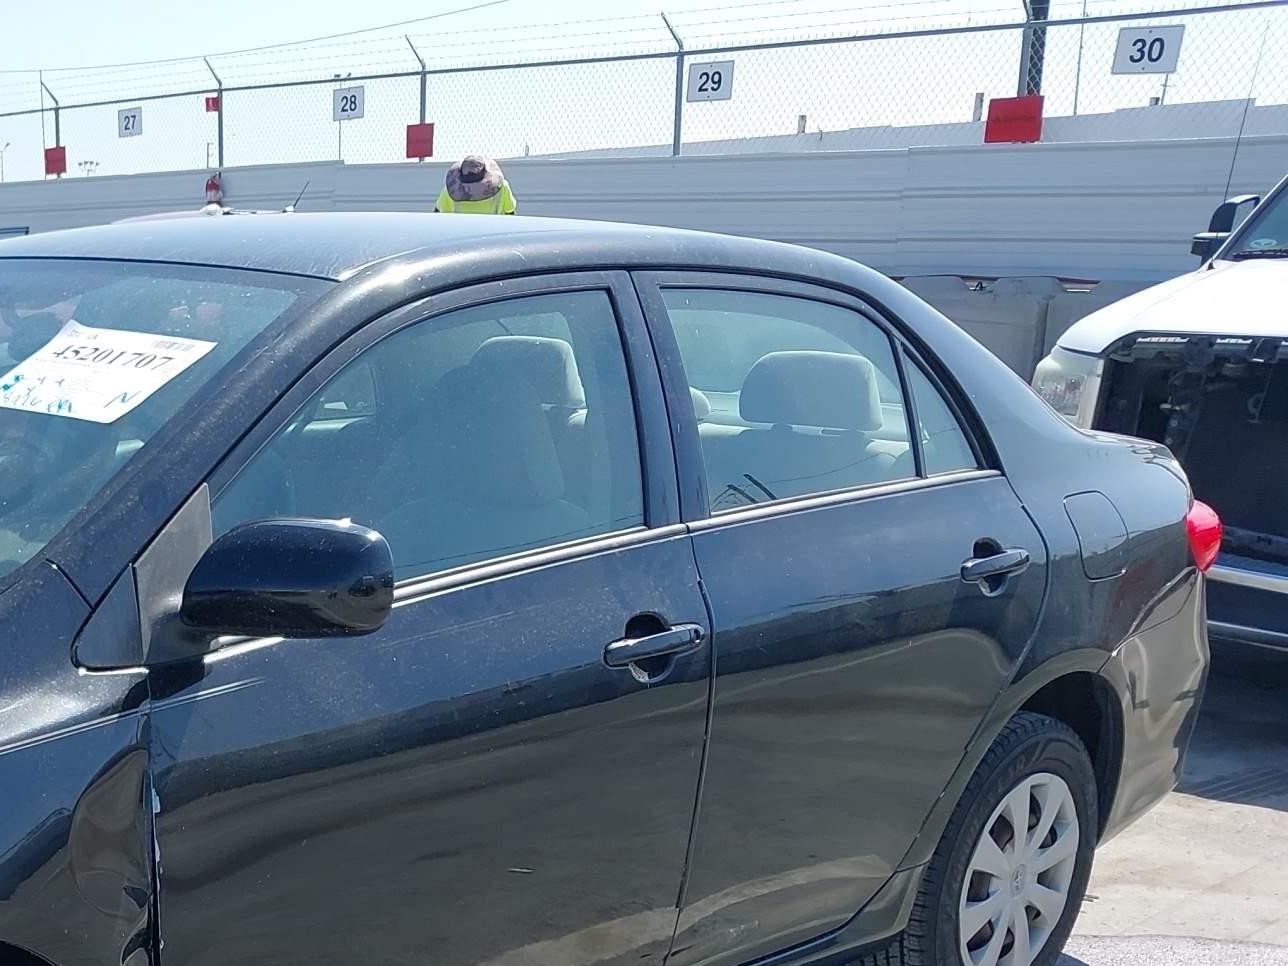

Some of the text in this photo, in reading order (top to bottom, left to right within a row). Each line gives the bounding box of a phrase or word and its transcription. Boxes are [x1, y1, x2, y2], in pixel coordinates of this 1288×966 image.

[1129, 37, 1165, 64] 30
[697, 71, 722, 92] 29
[340, 94, 358, 113] 28
[123, 114, 137, 131] 27
[52, 344, 176, 371] 45201707
